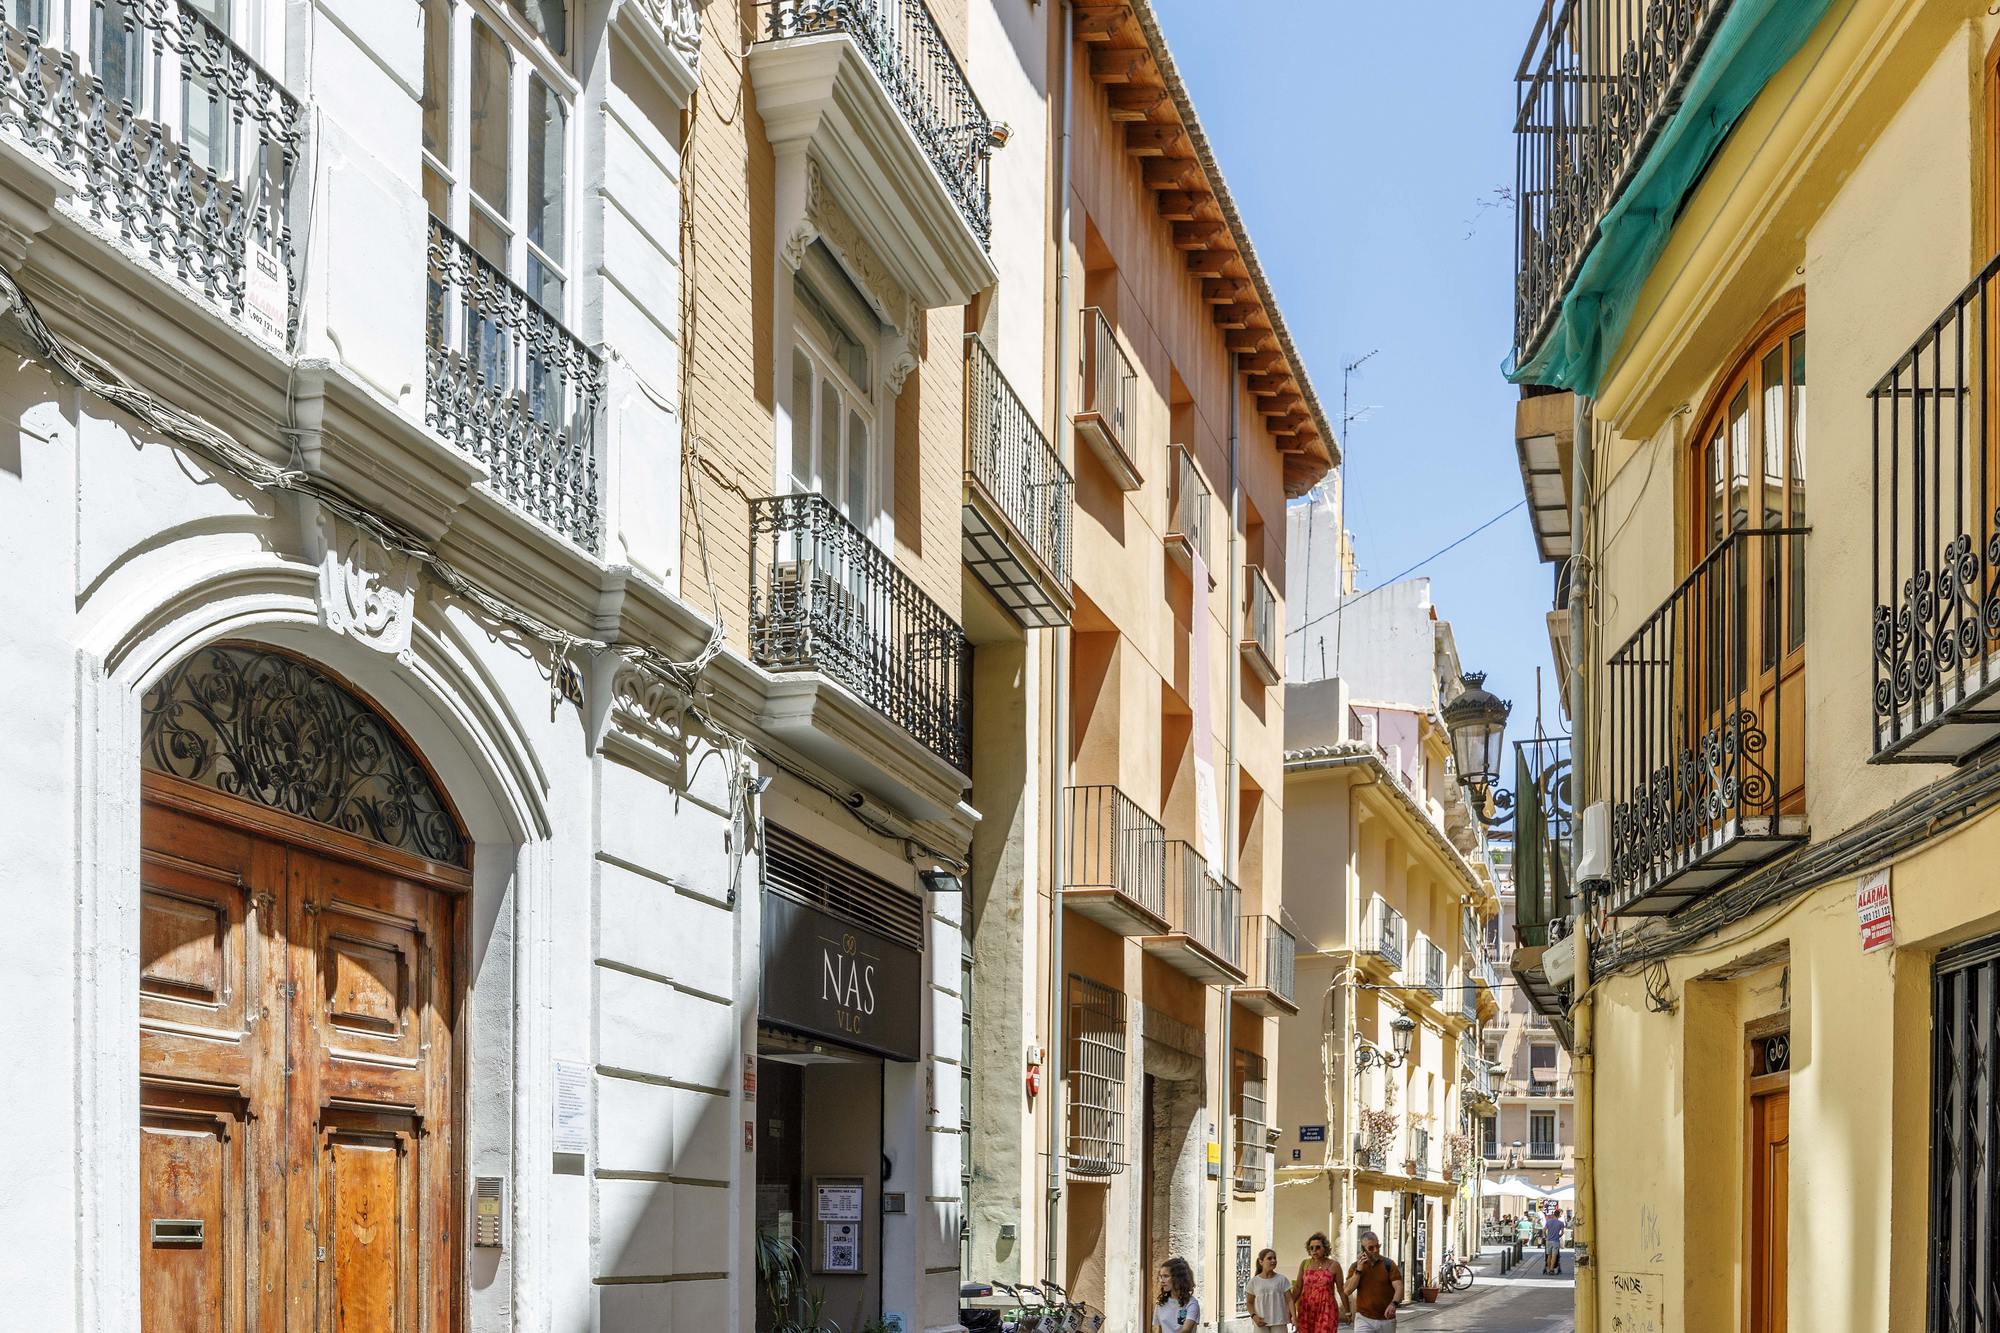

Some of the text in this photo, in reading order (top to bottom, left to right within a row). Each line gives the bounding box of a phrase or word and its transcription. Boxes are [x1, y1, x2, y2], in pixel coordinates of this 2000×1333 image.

[252, 312, 263, 325] 902
[264, 320, 273, 332] 121
[275, 328, 284, 340] 122
[1858, 884, 1888, 908] ALARMA
[1863, 913, 1872, 922] 902
[1872, 909, 1880, 919] 121
[822, 948, 875, 1015] NAS
[837, 1010, 861, 1034] VLC
